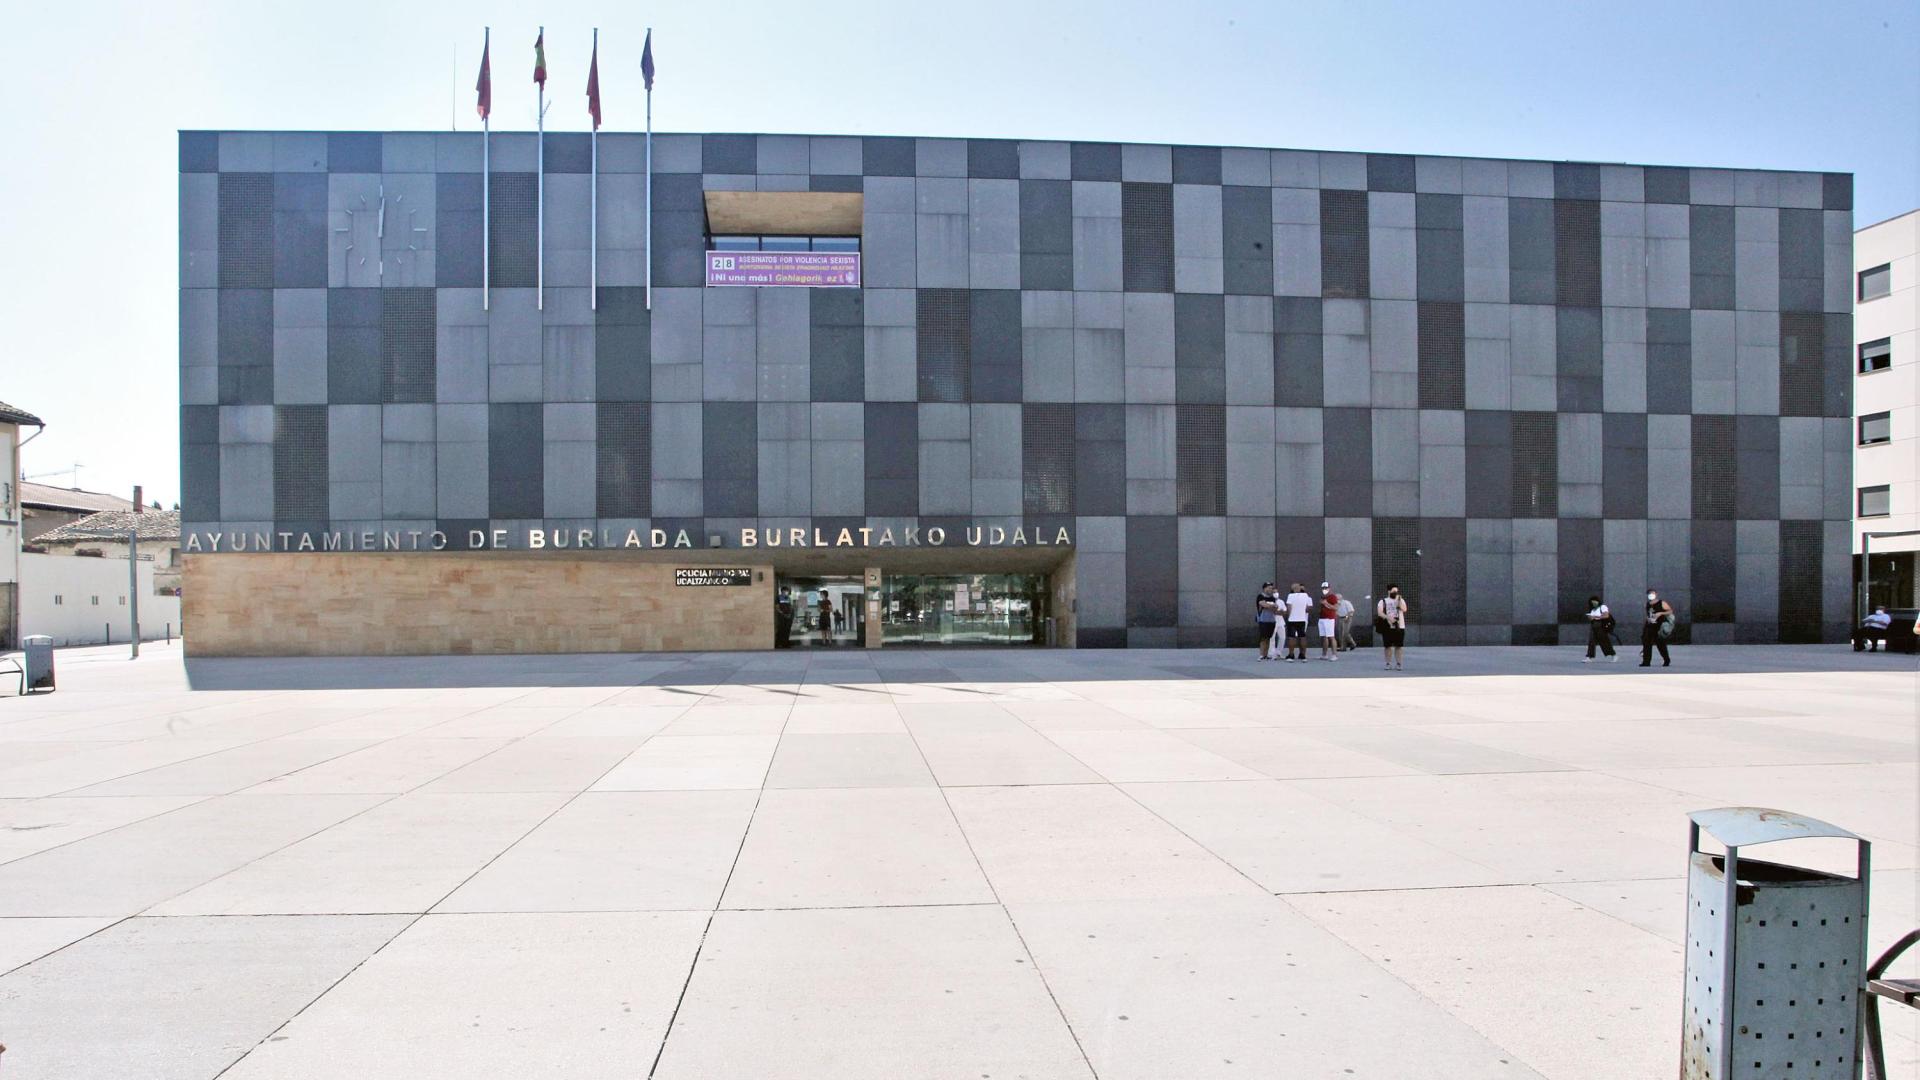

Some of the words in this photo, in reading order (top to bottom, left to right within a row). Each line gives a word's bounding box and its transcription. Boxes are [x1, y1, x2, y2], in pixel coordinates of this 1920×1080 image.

[187, 529, 448, 552] AYUNTAMIENTO
[469, 530, 507, 549] DE
[528, 528, 692, 548] BURLADA
[741, 526, 946, 547] BURLATAKO
[966, 526, 1072, 546] UDALA
[676, 569, 708, 577] POLICIA
